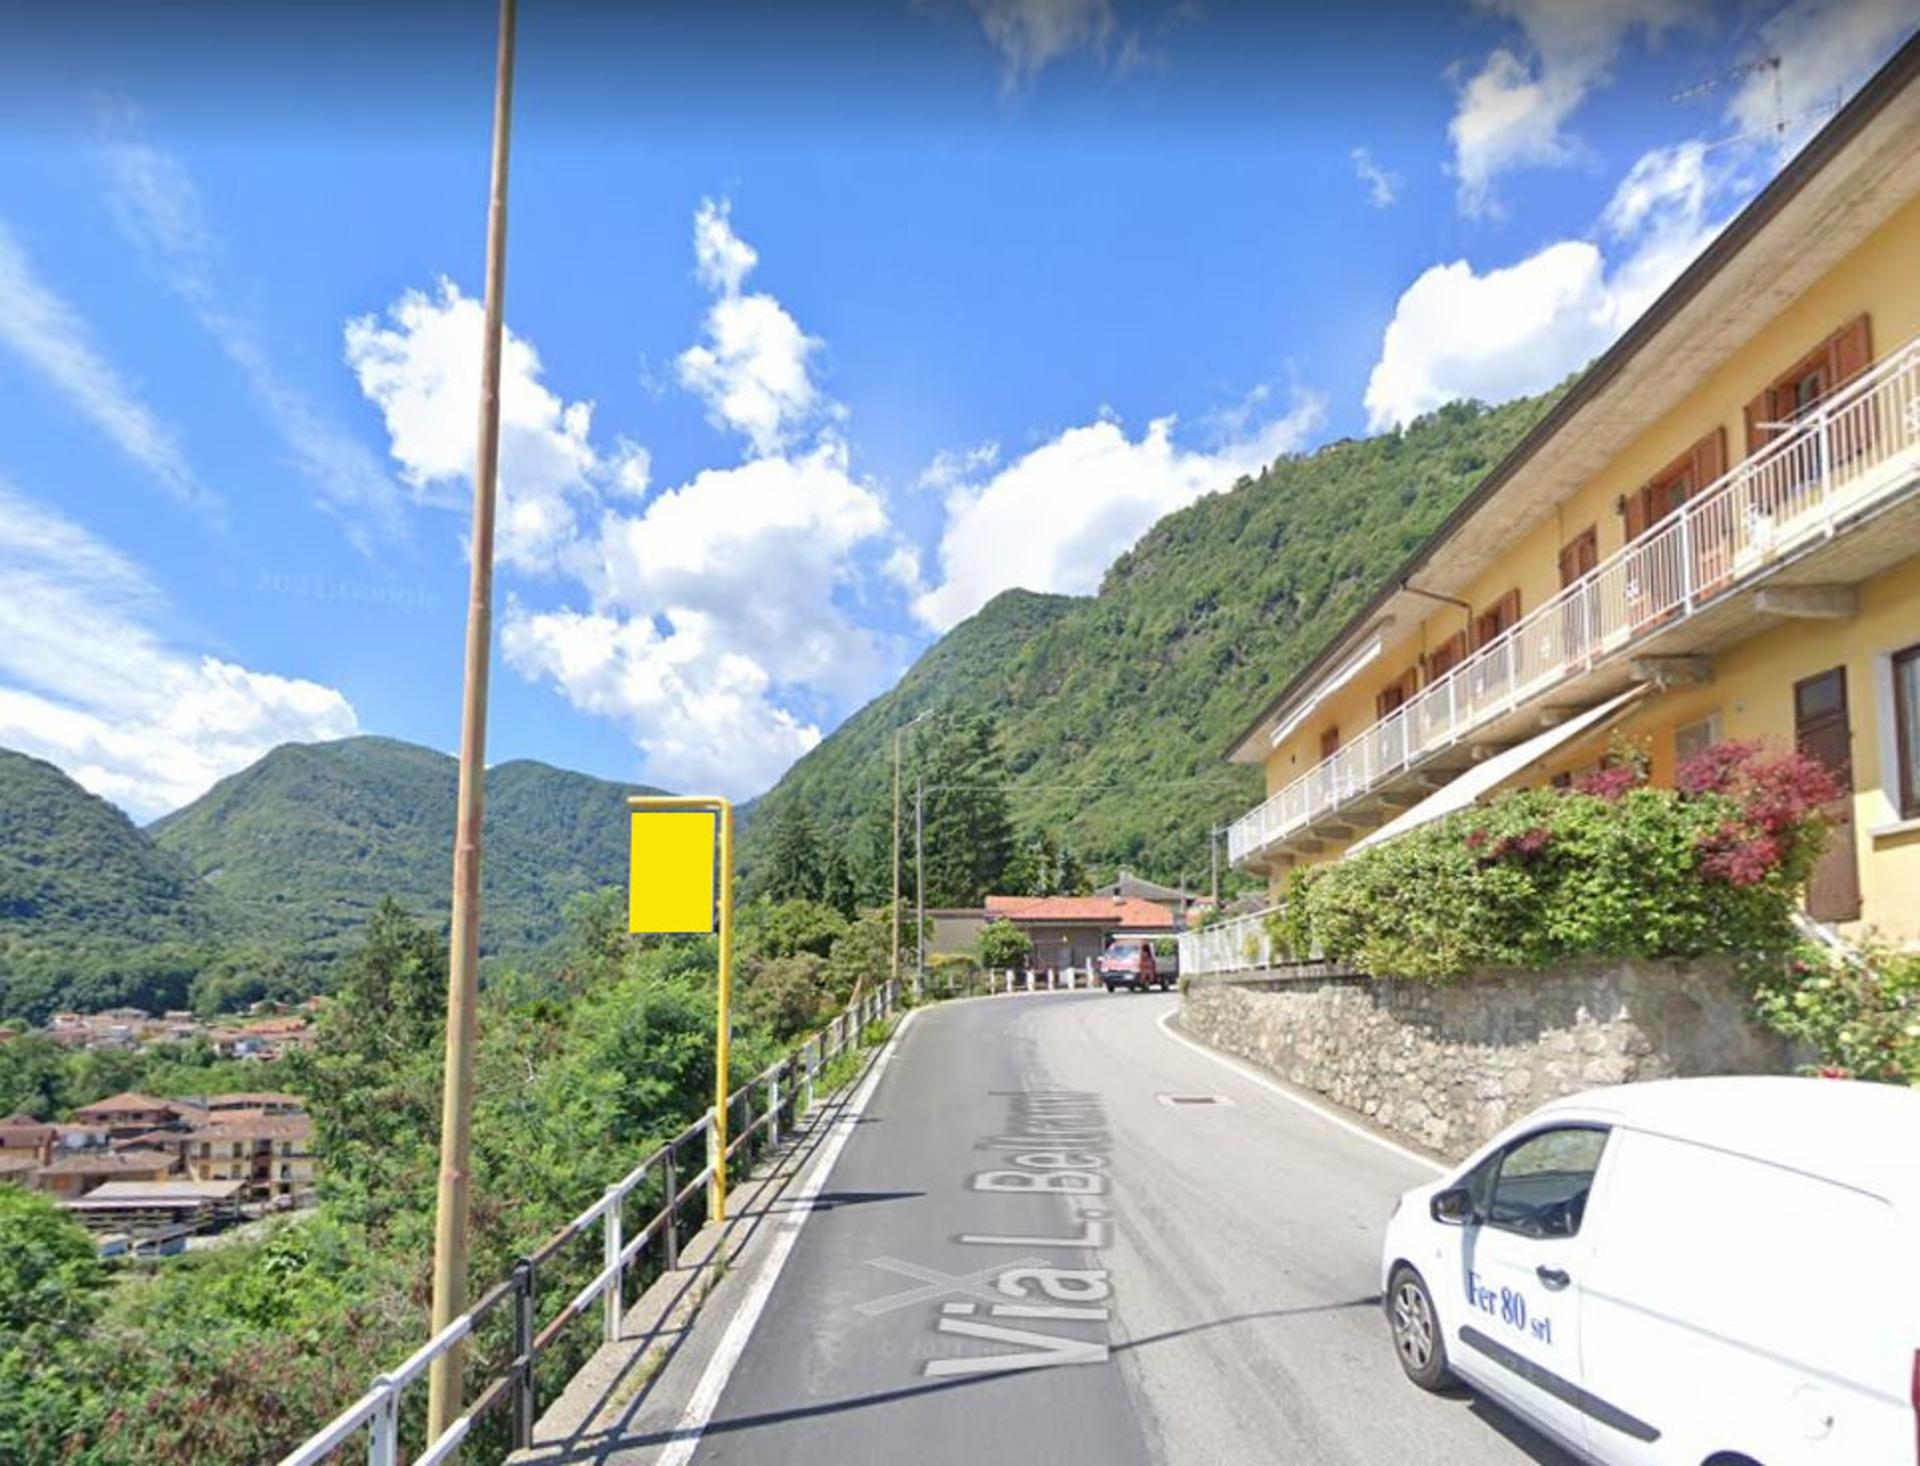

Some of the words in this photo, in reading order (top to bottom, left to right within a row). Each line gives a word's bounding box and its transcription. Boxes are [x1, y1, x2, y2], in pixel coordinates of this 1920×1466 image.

[1467, 1271, 1498, 1315] Fer
[1501, 1286, 1526, 1331] 80
[1531, 1318, 1552, 1344] srl
